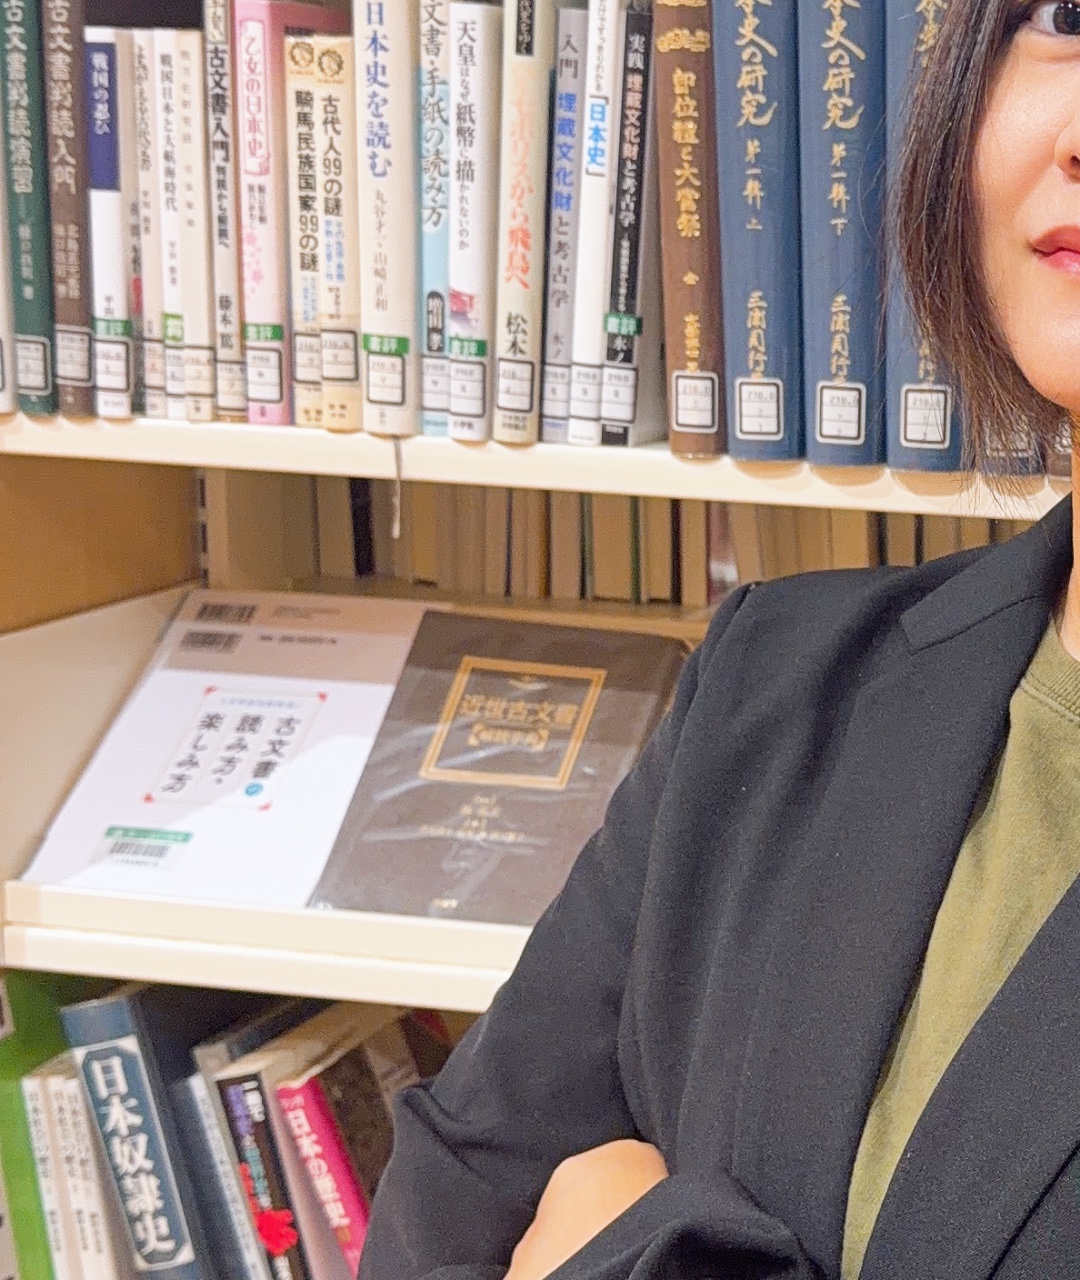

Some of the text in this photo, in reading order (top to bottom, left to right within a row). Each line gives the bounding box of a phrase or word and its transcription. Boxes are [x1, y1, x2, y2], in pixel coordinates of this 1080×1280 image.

[320, 94, 342, 216] 古代人99の謎
[366, 1, 392, 178] 日本史を読む
[454, 20, 477, 251] 天皇はなぜ紙幣に描かれないのか
[89, 1056, 176, 1256] 日本奴隷史
